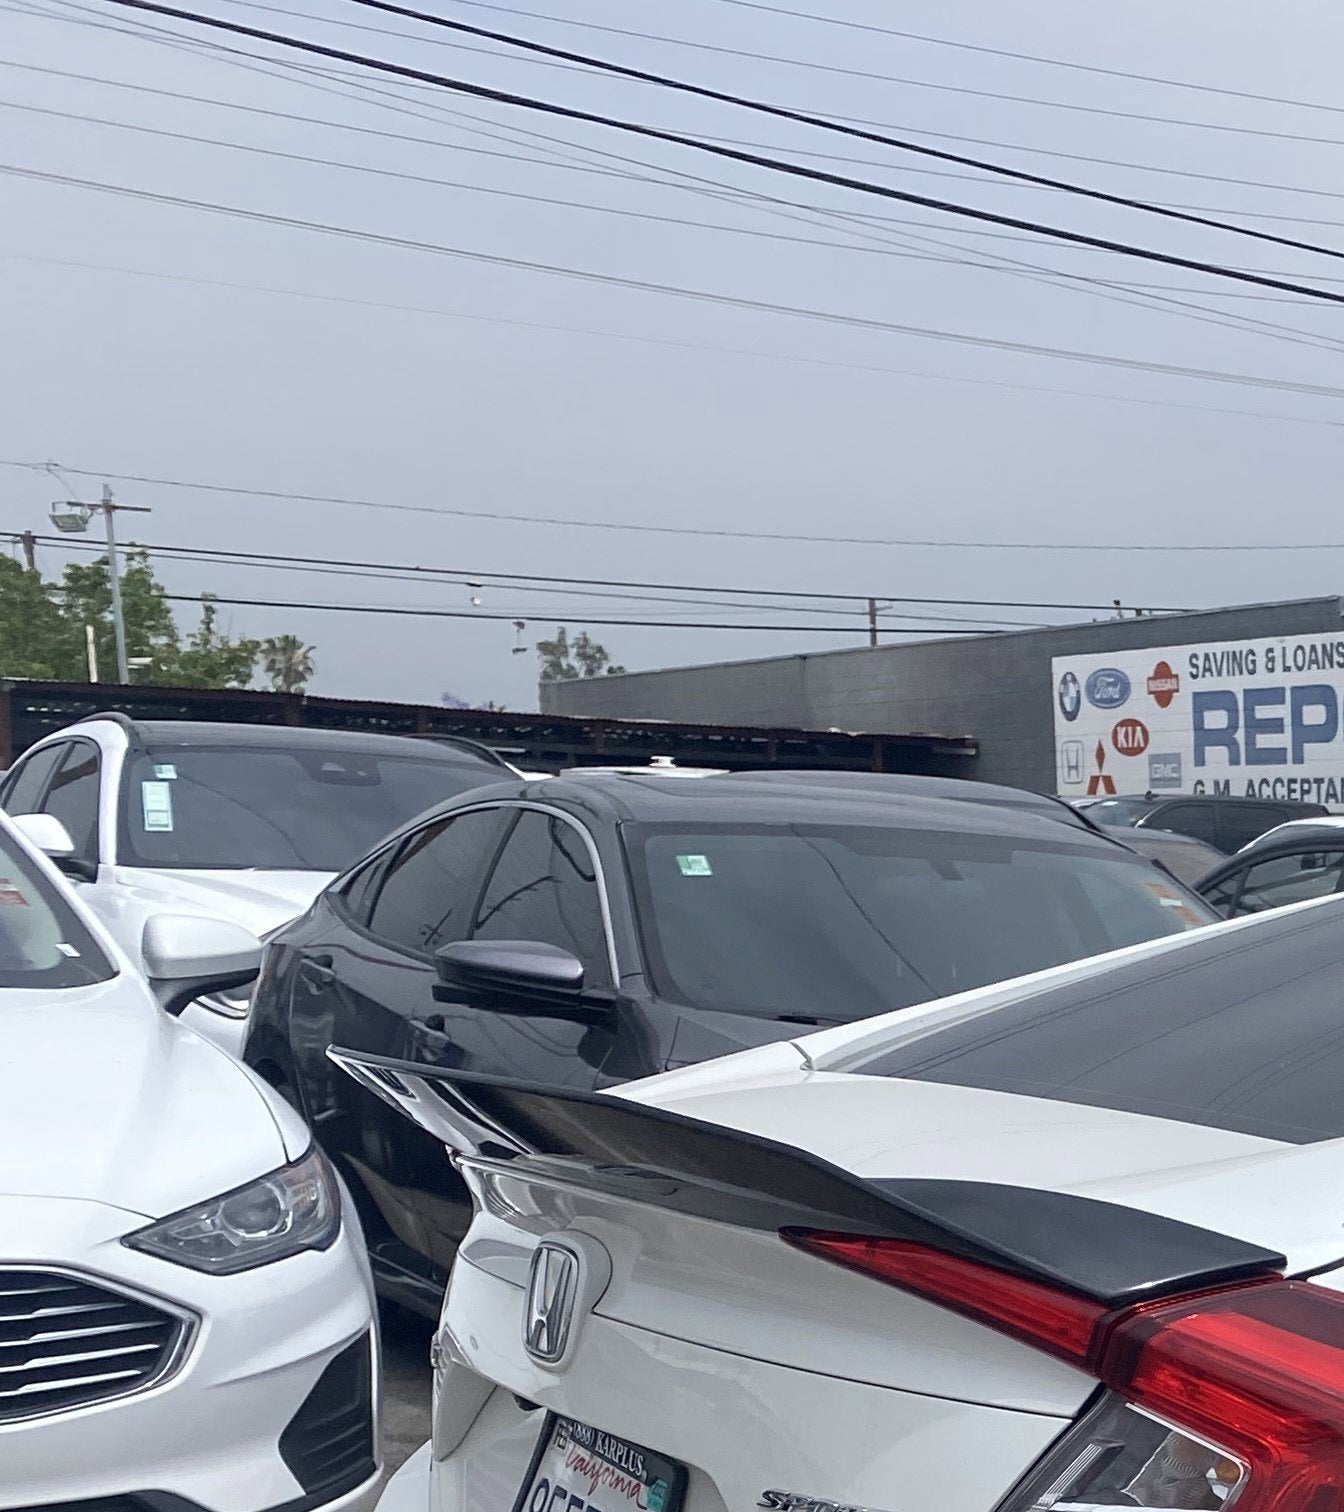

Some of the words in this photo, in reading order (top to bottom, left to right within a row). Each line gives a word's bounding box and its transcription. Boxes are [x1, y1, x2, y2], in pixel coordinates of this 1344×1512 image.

[1189, 649, 1256, 680] SAVING
[1093, 677, 1121, 699] Ford
[1116, 725, 1145, 748] KIA
[1150, 763, 1179, 777] GMC
[596, 1432, 645, 1475] KARPLUS
